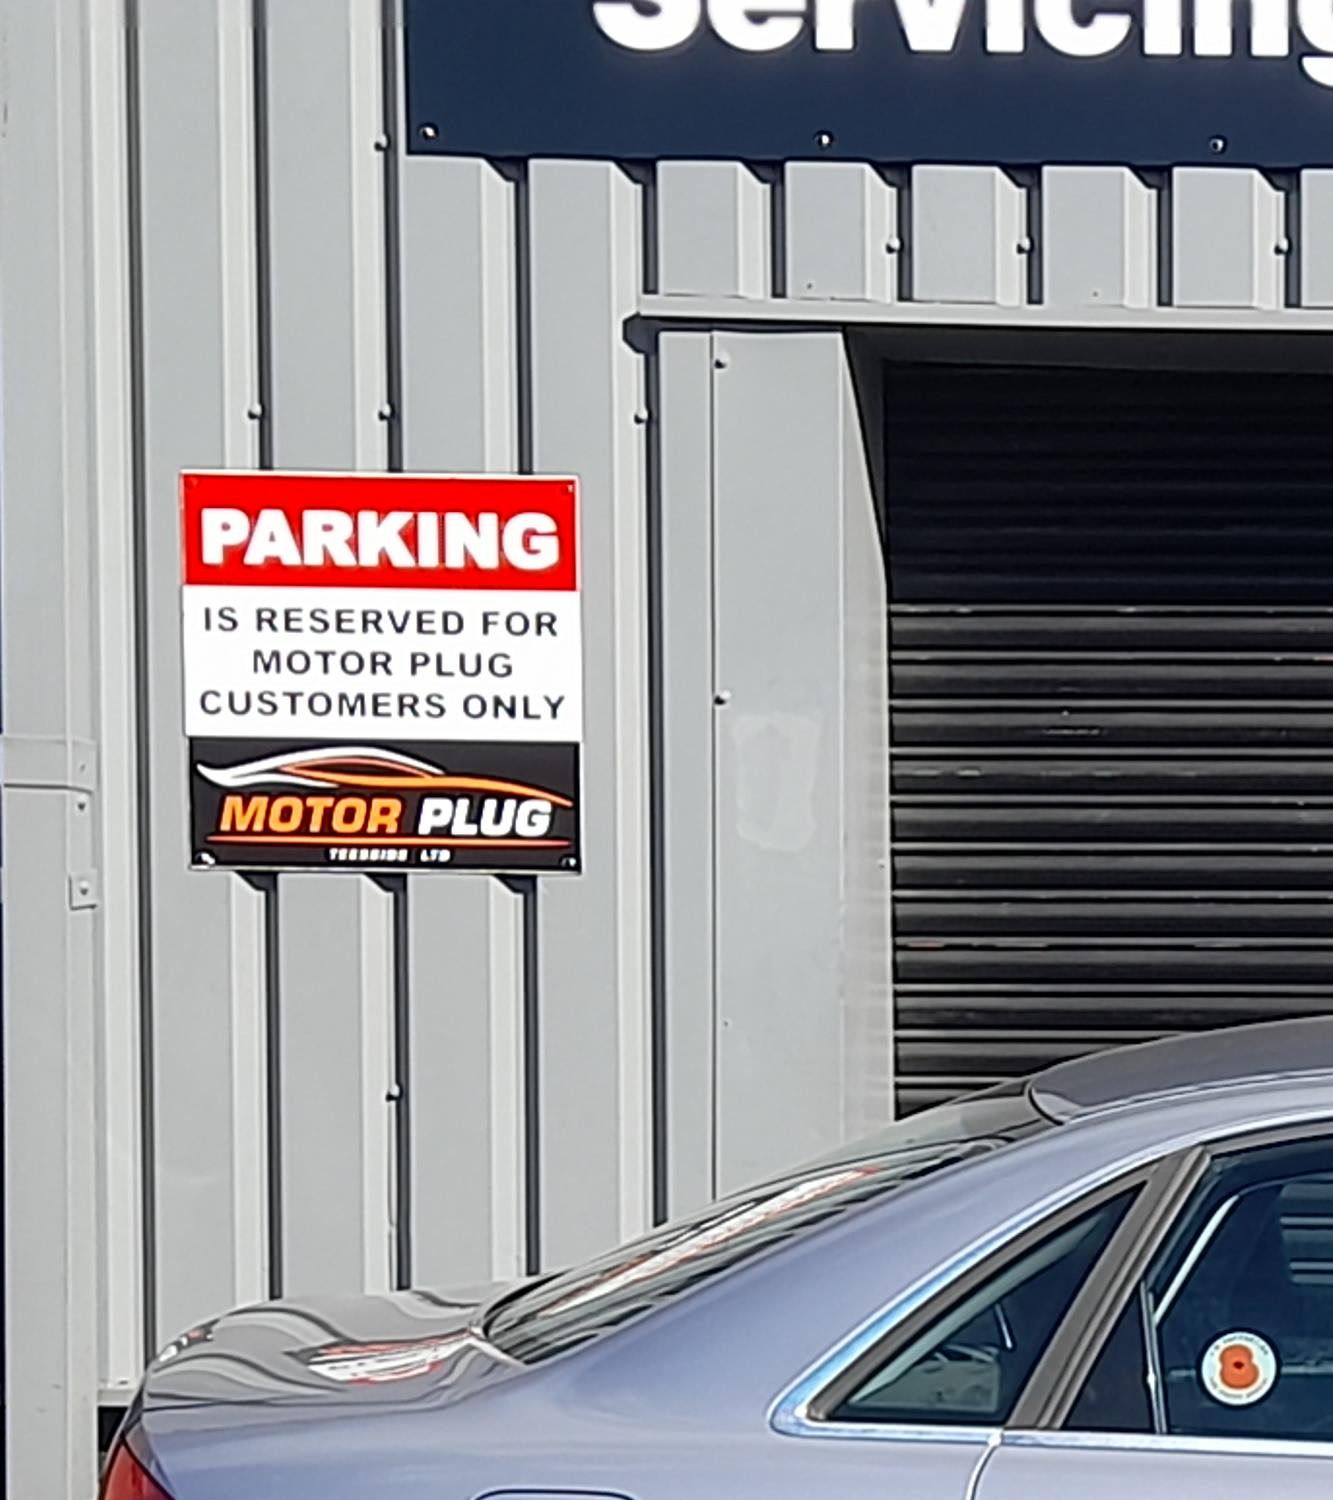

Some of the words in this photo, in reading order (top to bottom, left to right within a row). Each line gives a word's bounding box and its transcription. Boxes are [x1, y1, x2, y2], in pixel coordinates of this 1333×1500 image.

[201, 508, 560, 570] PARKING
[204, 607, 239, 632] IS
[256, 608, 464, 635] RESERVED
[482, 611, 557, 637] FOR
[253, 649, 392, 676] MOTOR
[410, 652, 513, 678] PLUG
[200, 690, 446, 719] CUSTOMERS
[462, 694, 566, 720] ONLY
[220, 796, 402, 834] MOTOR
[418, 798, 552, 837] PLUG
[420, 849, 451, 862] LTD
